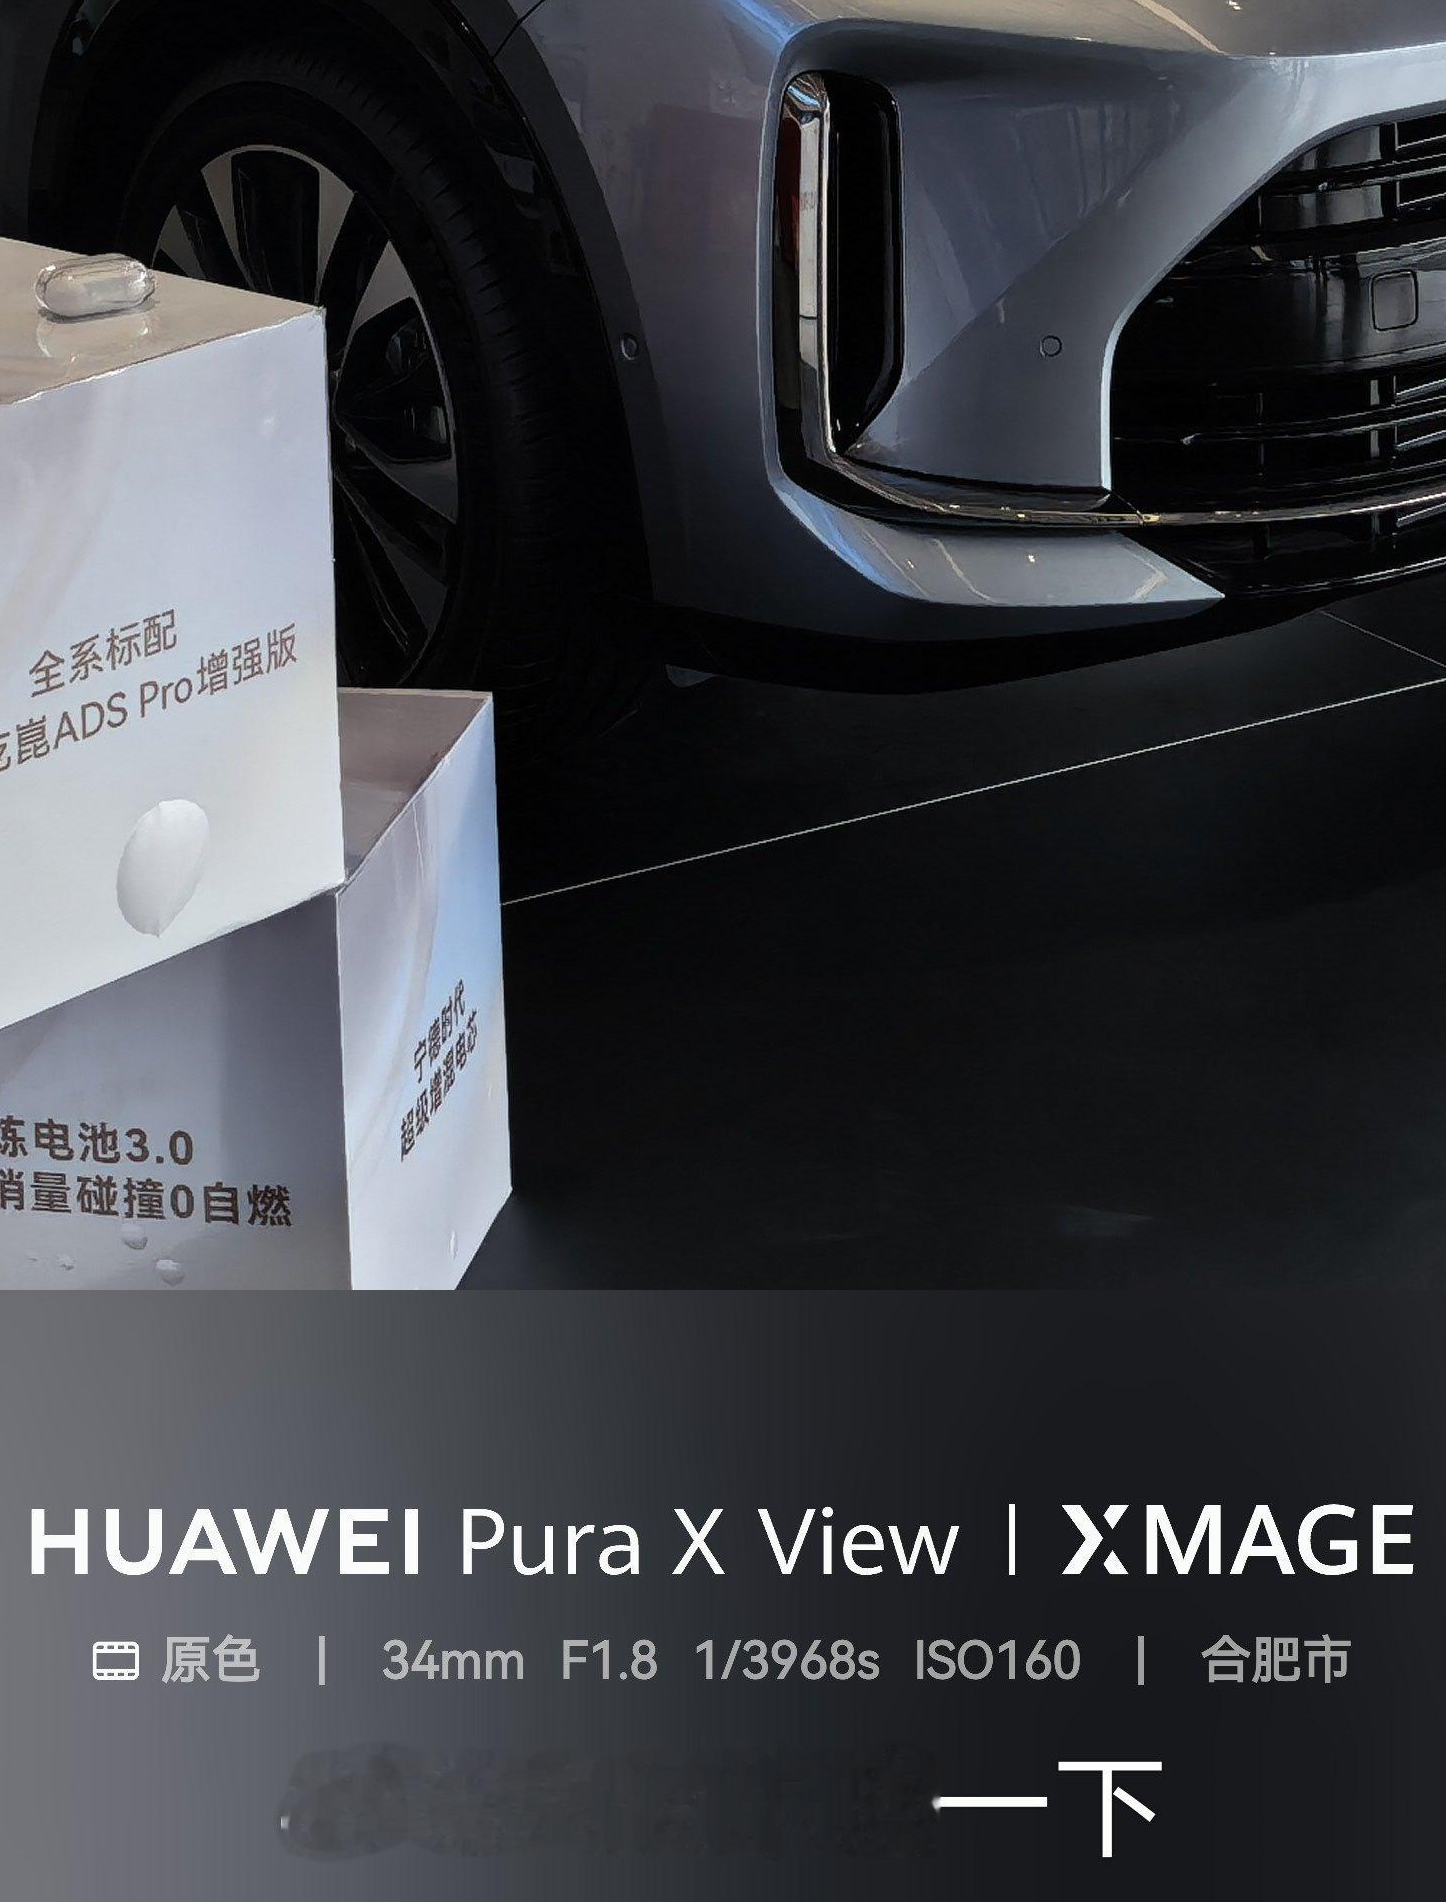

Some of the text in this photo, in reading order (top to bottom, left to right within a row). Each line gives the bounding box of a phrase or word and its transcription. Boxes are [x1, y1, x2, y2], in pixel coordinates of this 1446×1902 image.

[28, 608, 177, 698] 全系标配
[139, 622, 298, 718] Pro增强版
[413, 978, 466, 1084] 宁德时代
[400, 1008, 478, 1163] 超级增混电芯
